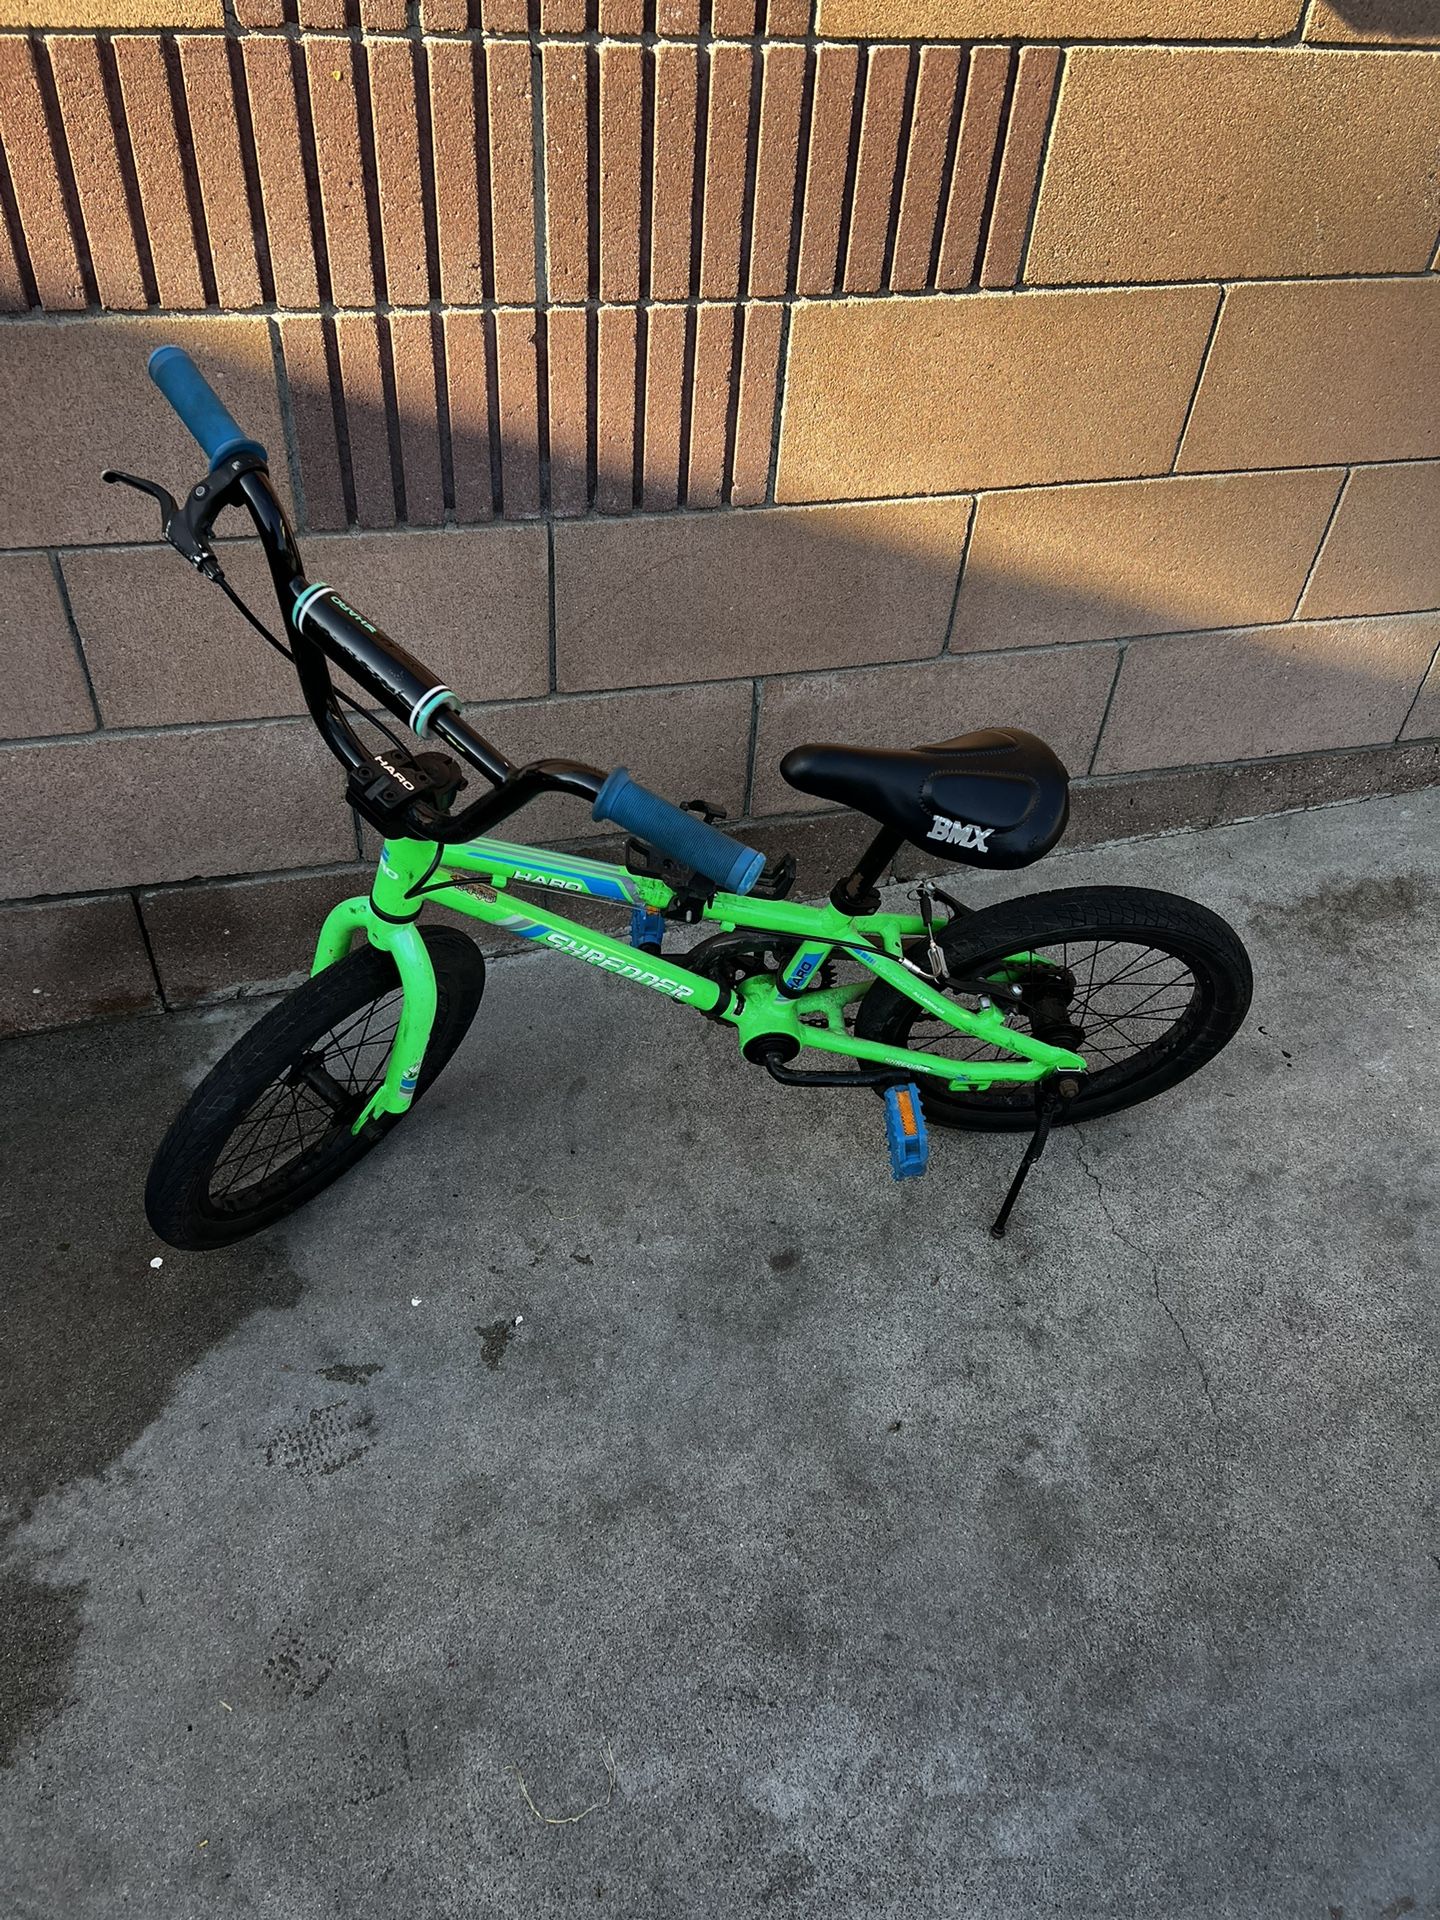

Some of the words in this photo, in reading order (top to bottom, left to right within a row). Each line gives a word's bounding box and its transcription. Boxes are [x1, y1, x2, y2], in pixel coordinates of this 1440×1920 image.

[374, 755, 415, 791] HARO
[926, 814, 995, 853] BMX
[513, 870, 583, 891] HARO
[546, 932, 695, 1000] SHREDDER
